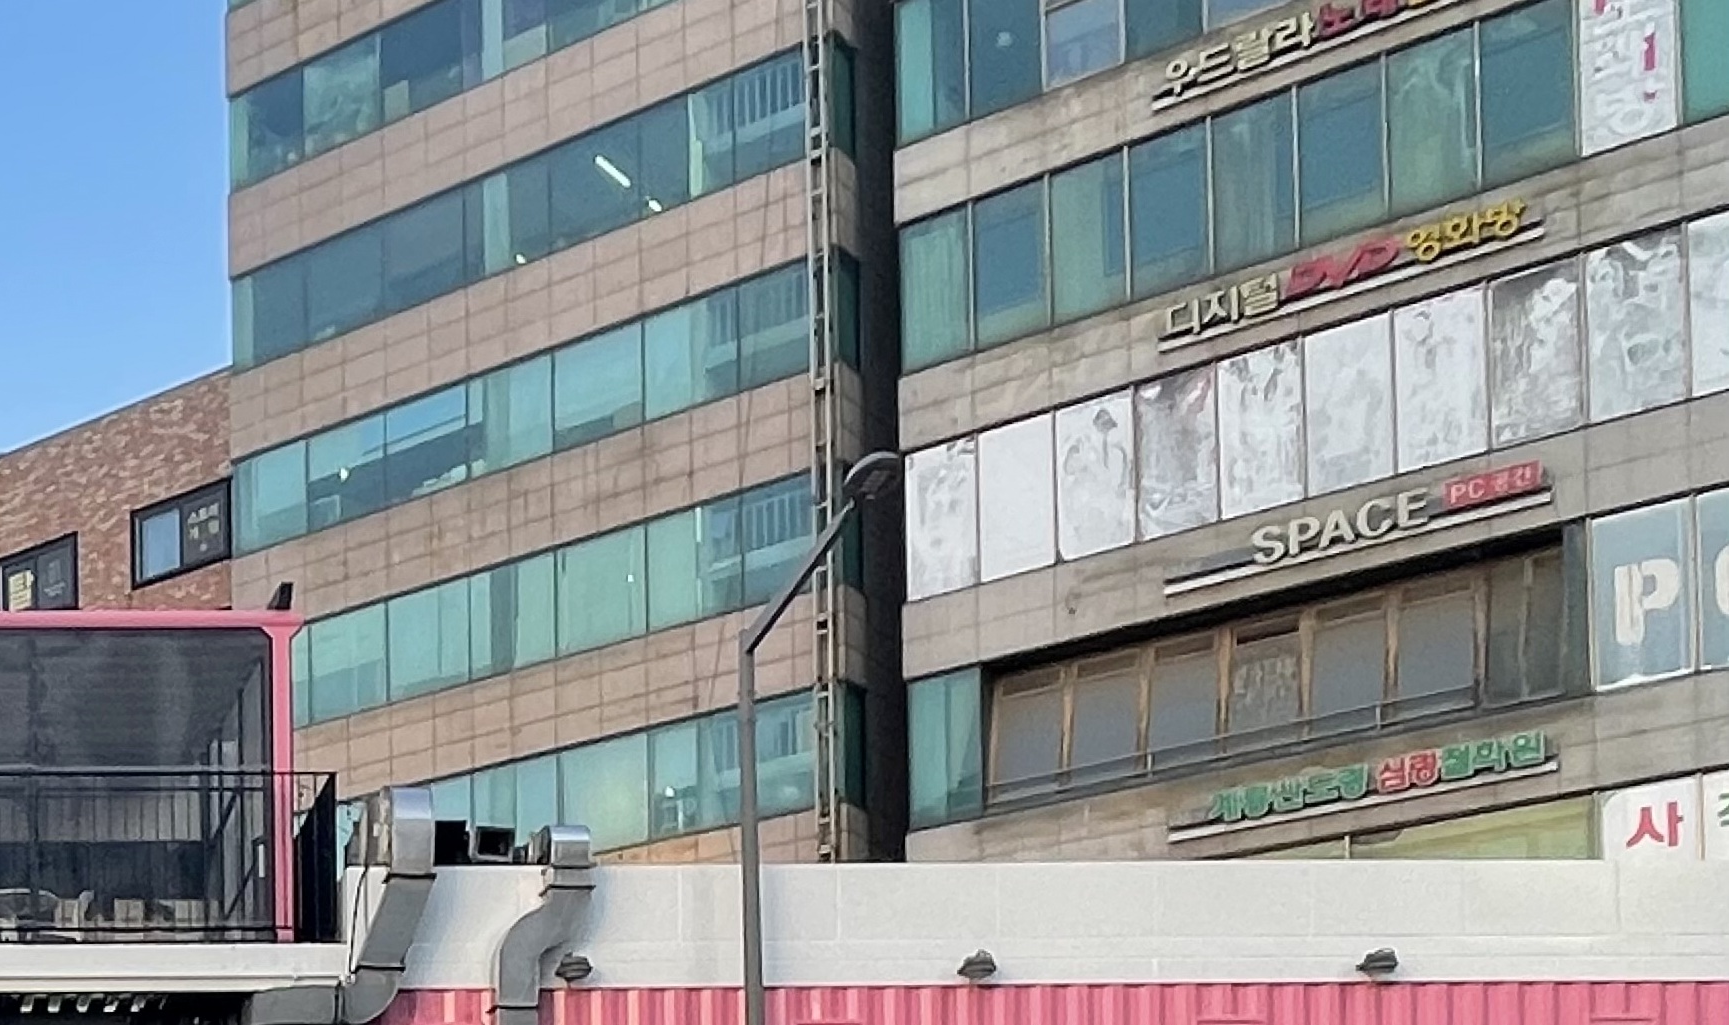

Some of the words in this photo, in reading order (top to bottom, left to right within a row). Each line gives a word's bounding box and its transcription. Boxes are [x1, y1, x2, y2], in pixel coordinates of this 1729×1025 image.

[1167, 271, 1280, 335] 디지털
[1450, 478, 1485, 505] PC
[1251, 486, 1430, 565] SPACE
